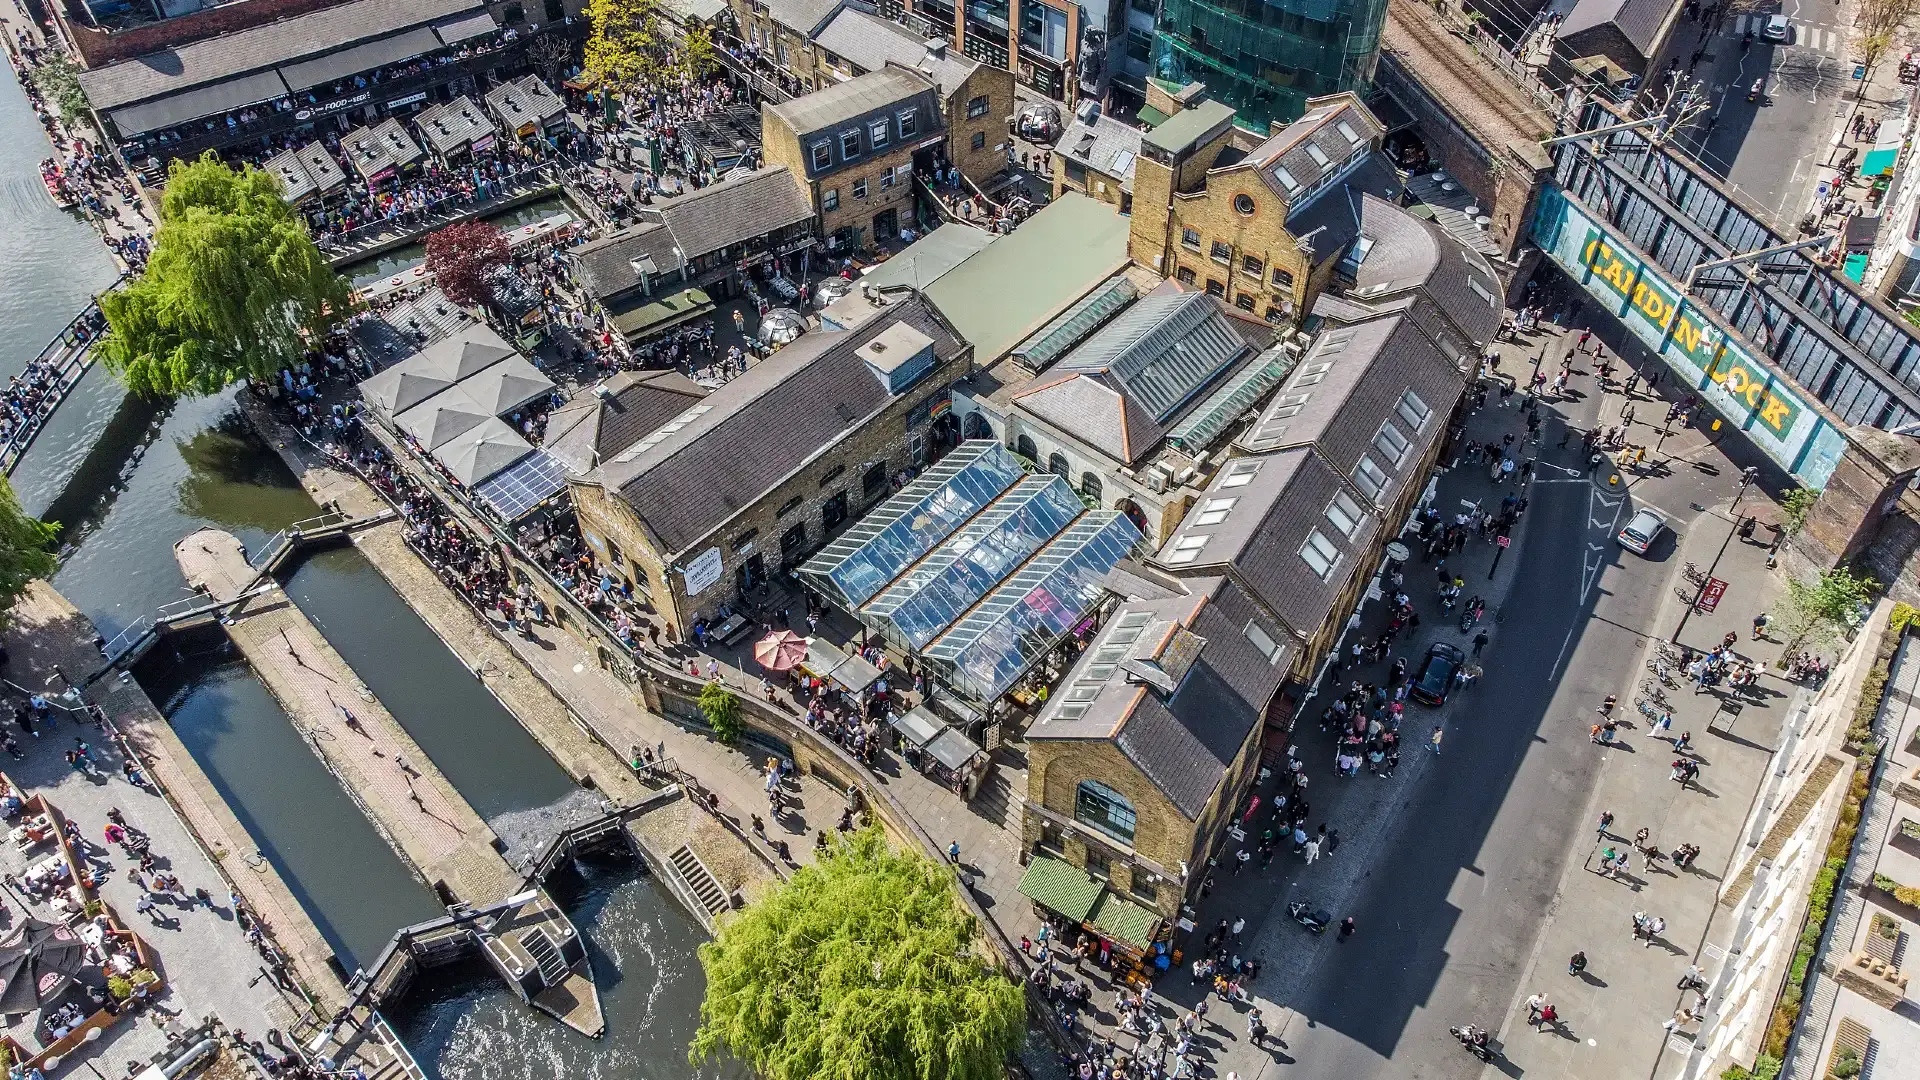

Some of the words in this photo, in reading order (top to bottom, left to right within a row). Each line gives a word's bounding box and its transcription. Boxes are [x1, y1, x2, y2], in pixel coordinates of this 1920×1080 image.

[325, 99, 347, 110] FOOD
[1586, 239, 1703, 353] CAMDEN
[1704, 341, 1792, 431] LOCK
